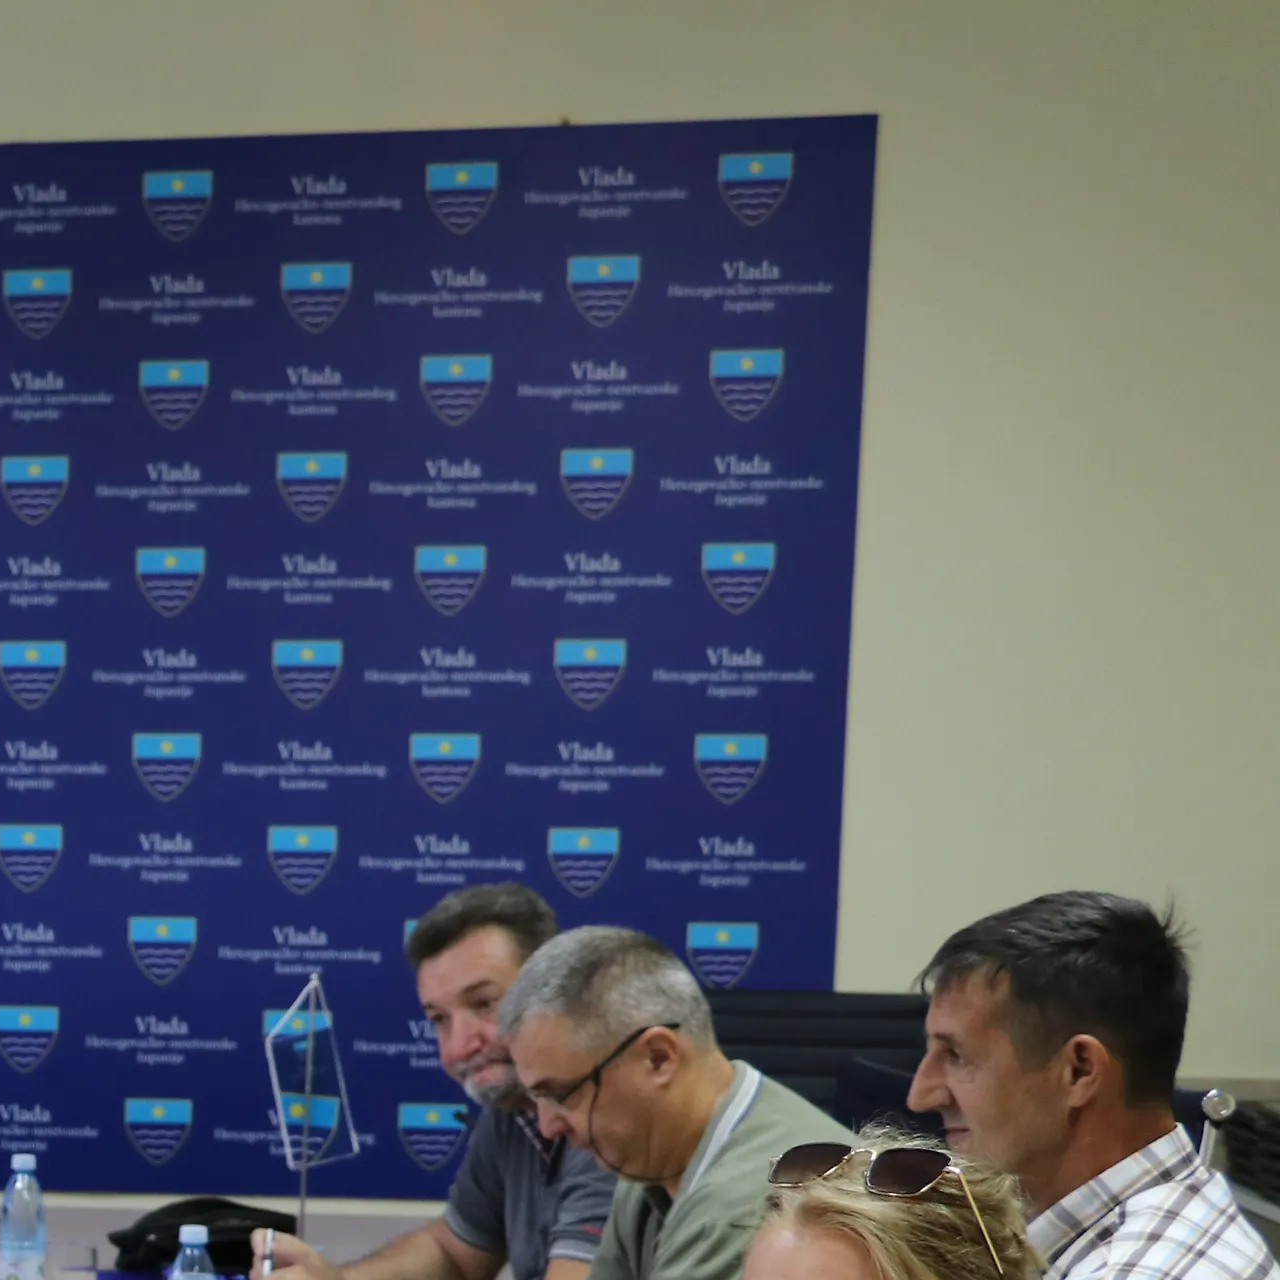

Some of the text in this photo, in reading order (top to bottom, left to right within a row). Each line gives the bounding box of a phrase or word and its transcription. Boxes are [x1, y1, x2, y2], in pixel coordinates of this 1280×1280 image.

[290, 174, 347, 197] Vlada
[578, 165, 635, 188] Vlada
[12, 182, 68, 204] Vlada
[430, 266, 488, 289] Vlada
[722, 259, 780, 282] Vlada
[149, 273, 205, 295] Vlada
[10, 370, 65, 392] Vlada
[286, 364, 342, 387] Vlada
[570, 359, 628, 383] Vlada
[146, 461, 201, 484] Vlada
[425, 457, 482, 481] Vlada
[714, 453, 772, 476] Vlada
[7, 555, 62, 577] Vlada
[281, 553, 338, 576] Vlada
[563, 551, 622, 574] Vlada
[142, 648, 198, 669] Vlada
[419, 647, 476, 668] Vlada
[706, 646, 764, 668] Vlada
[4, 740, 59, 761] Vlada
[277, 740, 333, 762] Vlada
[557, 741, 615, 762] Vlada
[138, 832, 193, 853] Vlada
[414, 834, 471, 855] Vlada
[698, 836, 755, 857] Vlada
[1, 922, 55, 943] Vlada
[272, 925, 328, 946] Vlada
[134, 1015, 189, 1036] Vlada
